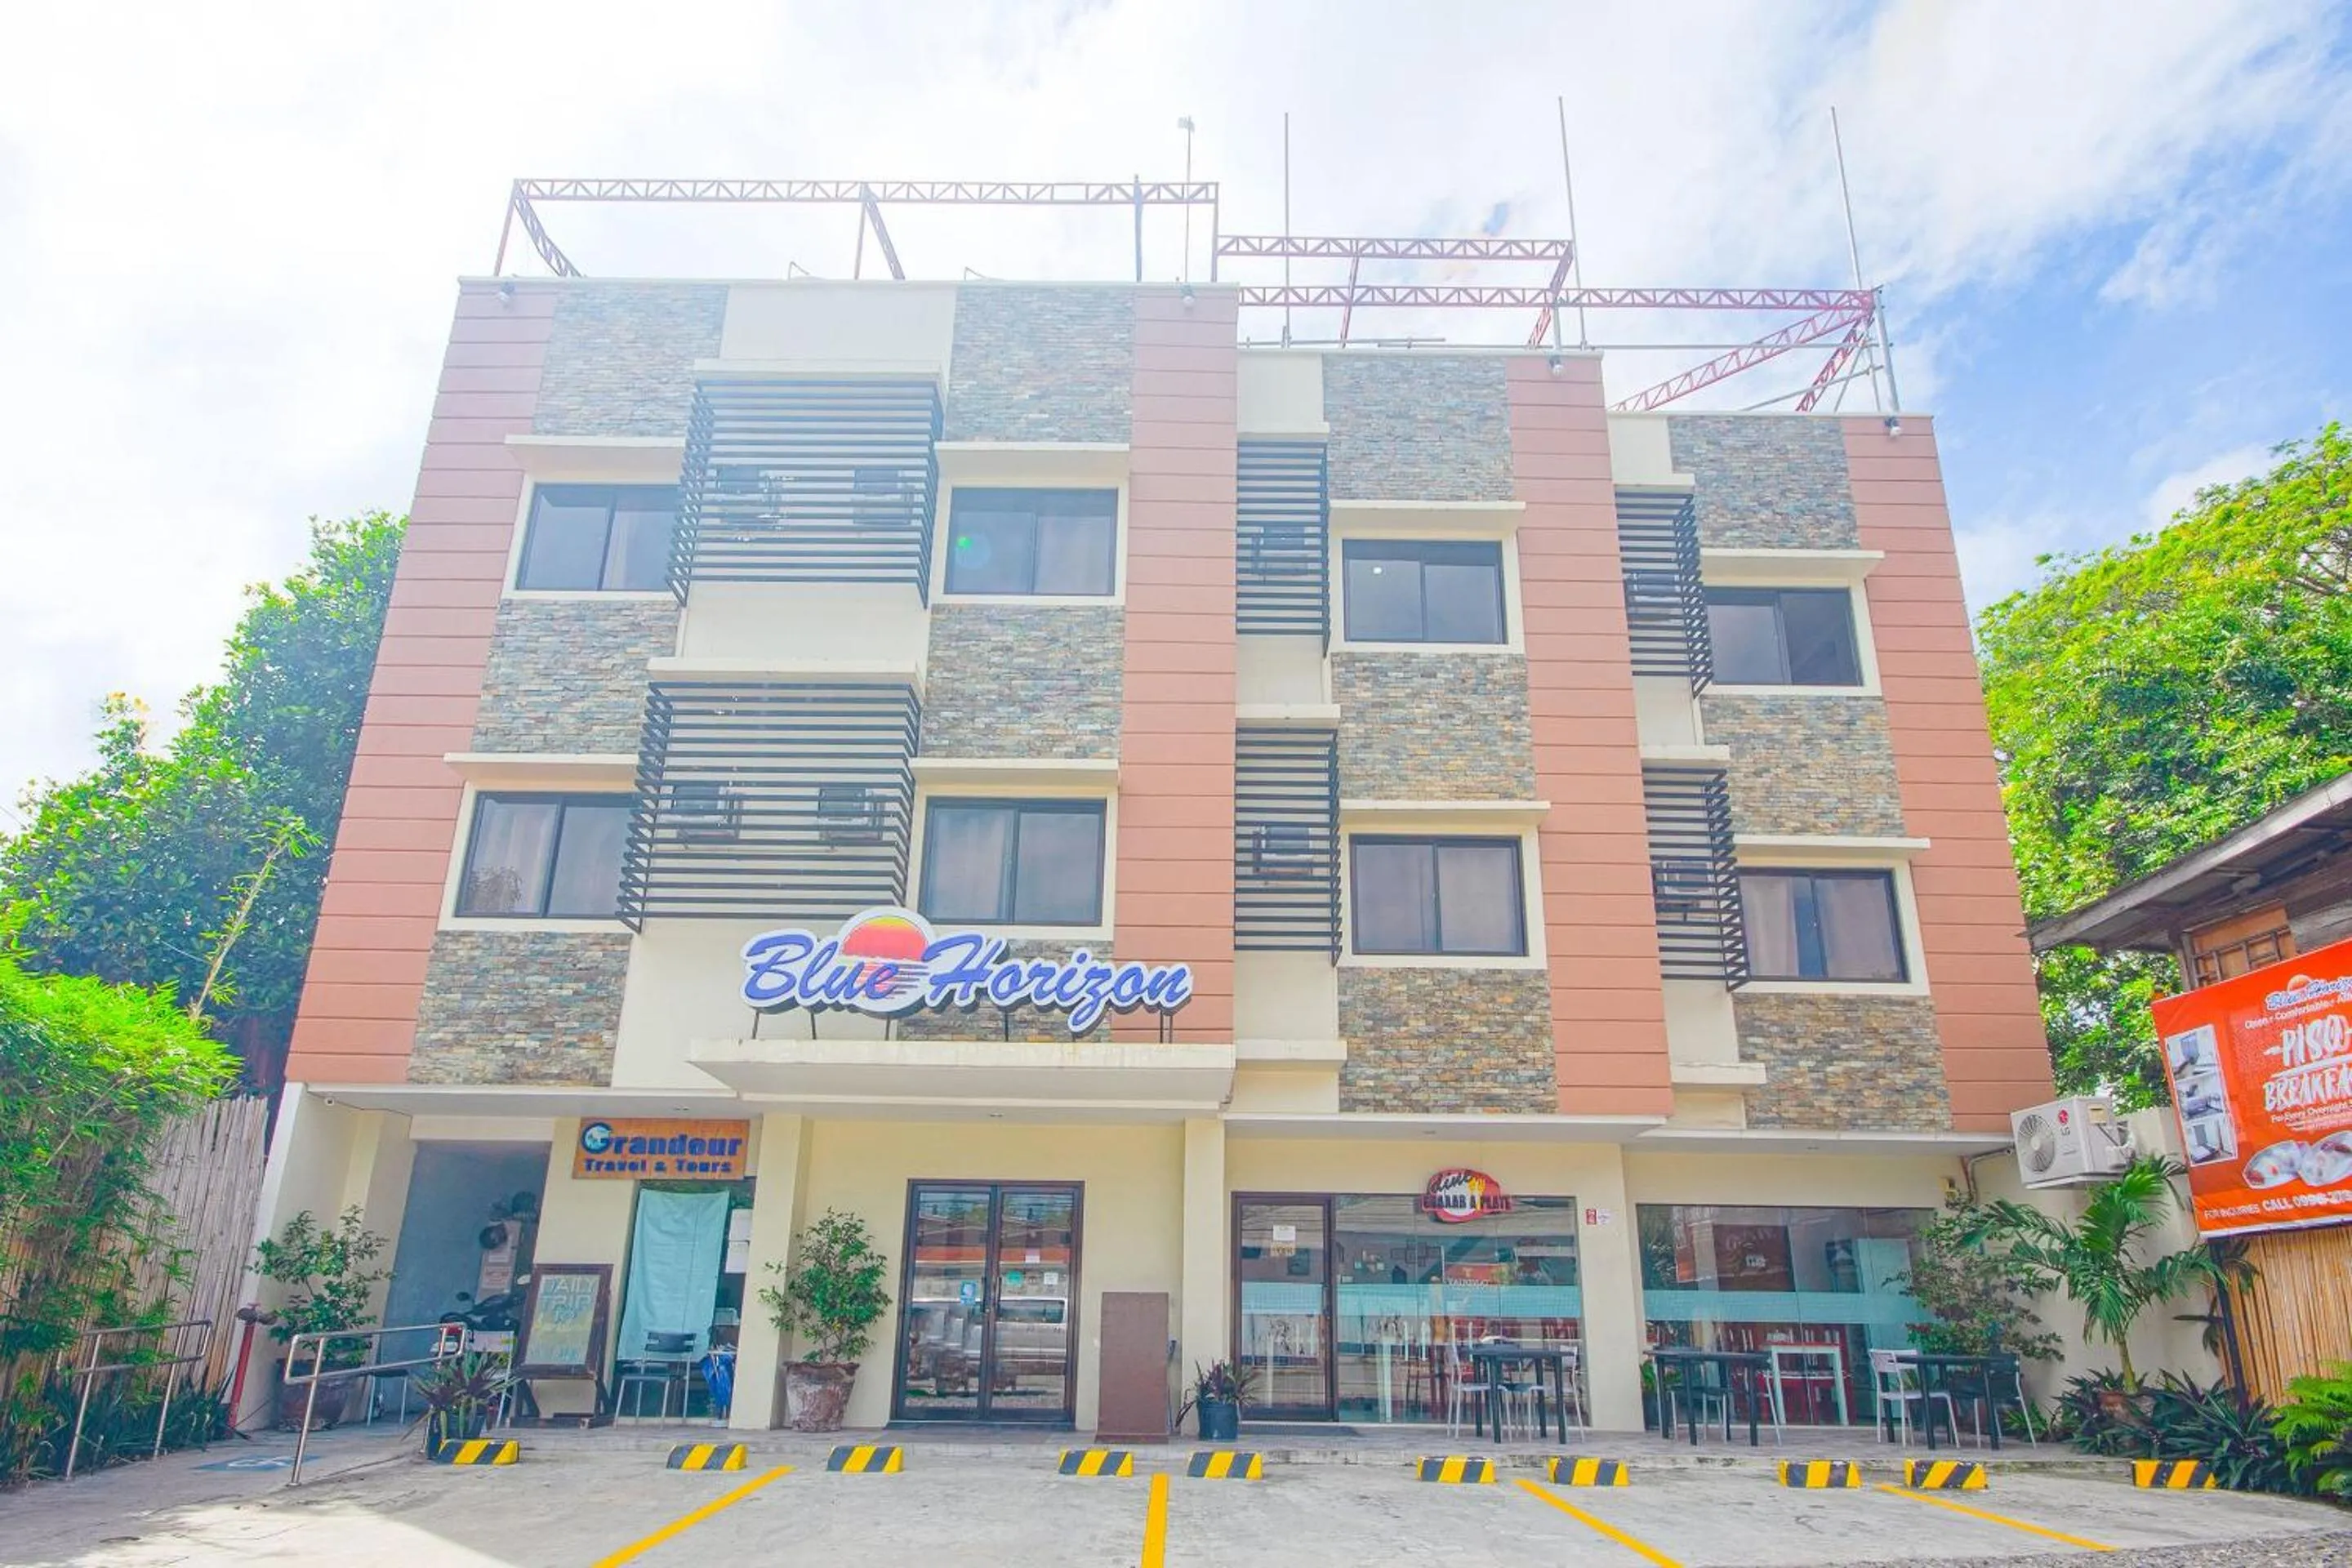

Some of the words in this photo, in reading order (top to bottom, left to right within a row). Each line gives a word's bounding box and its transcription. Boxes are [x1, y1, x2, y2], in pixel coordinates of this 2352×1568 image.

[743, 933, 899, 1002] Blue
[920, 933, 1189, 1031] Horizon
[2266, 989, 2306, 1010] Blue
[2283, 1014, 2350, 1067] PISO
[584, 1158, 647, 1172] Travel
[675, 1158, 731, 1172] Tours
[2263, 1198, 2292, 1211] CALL
